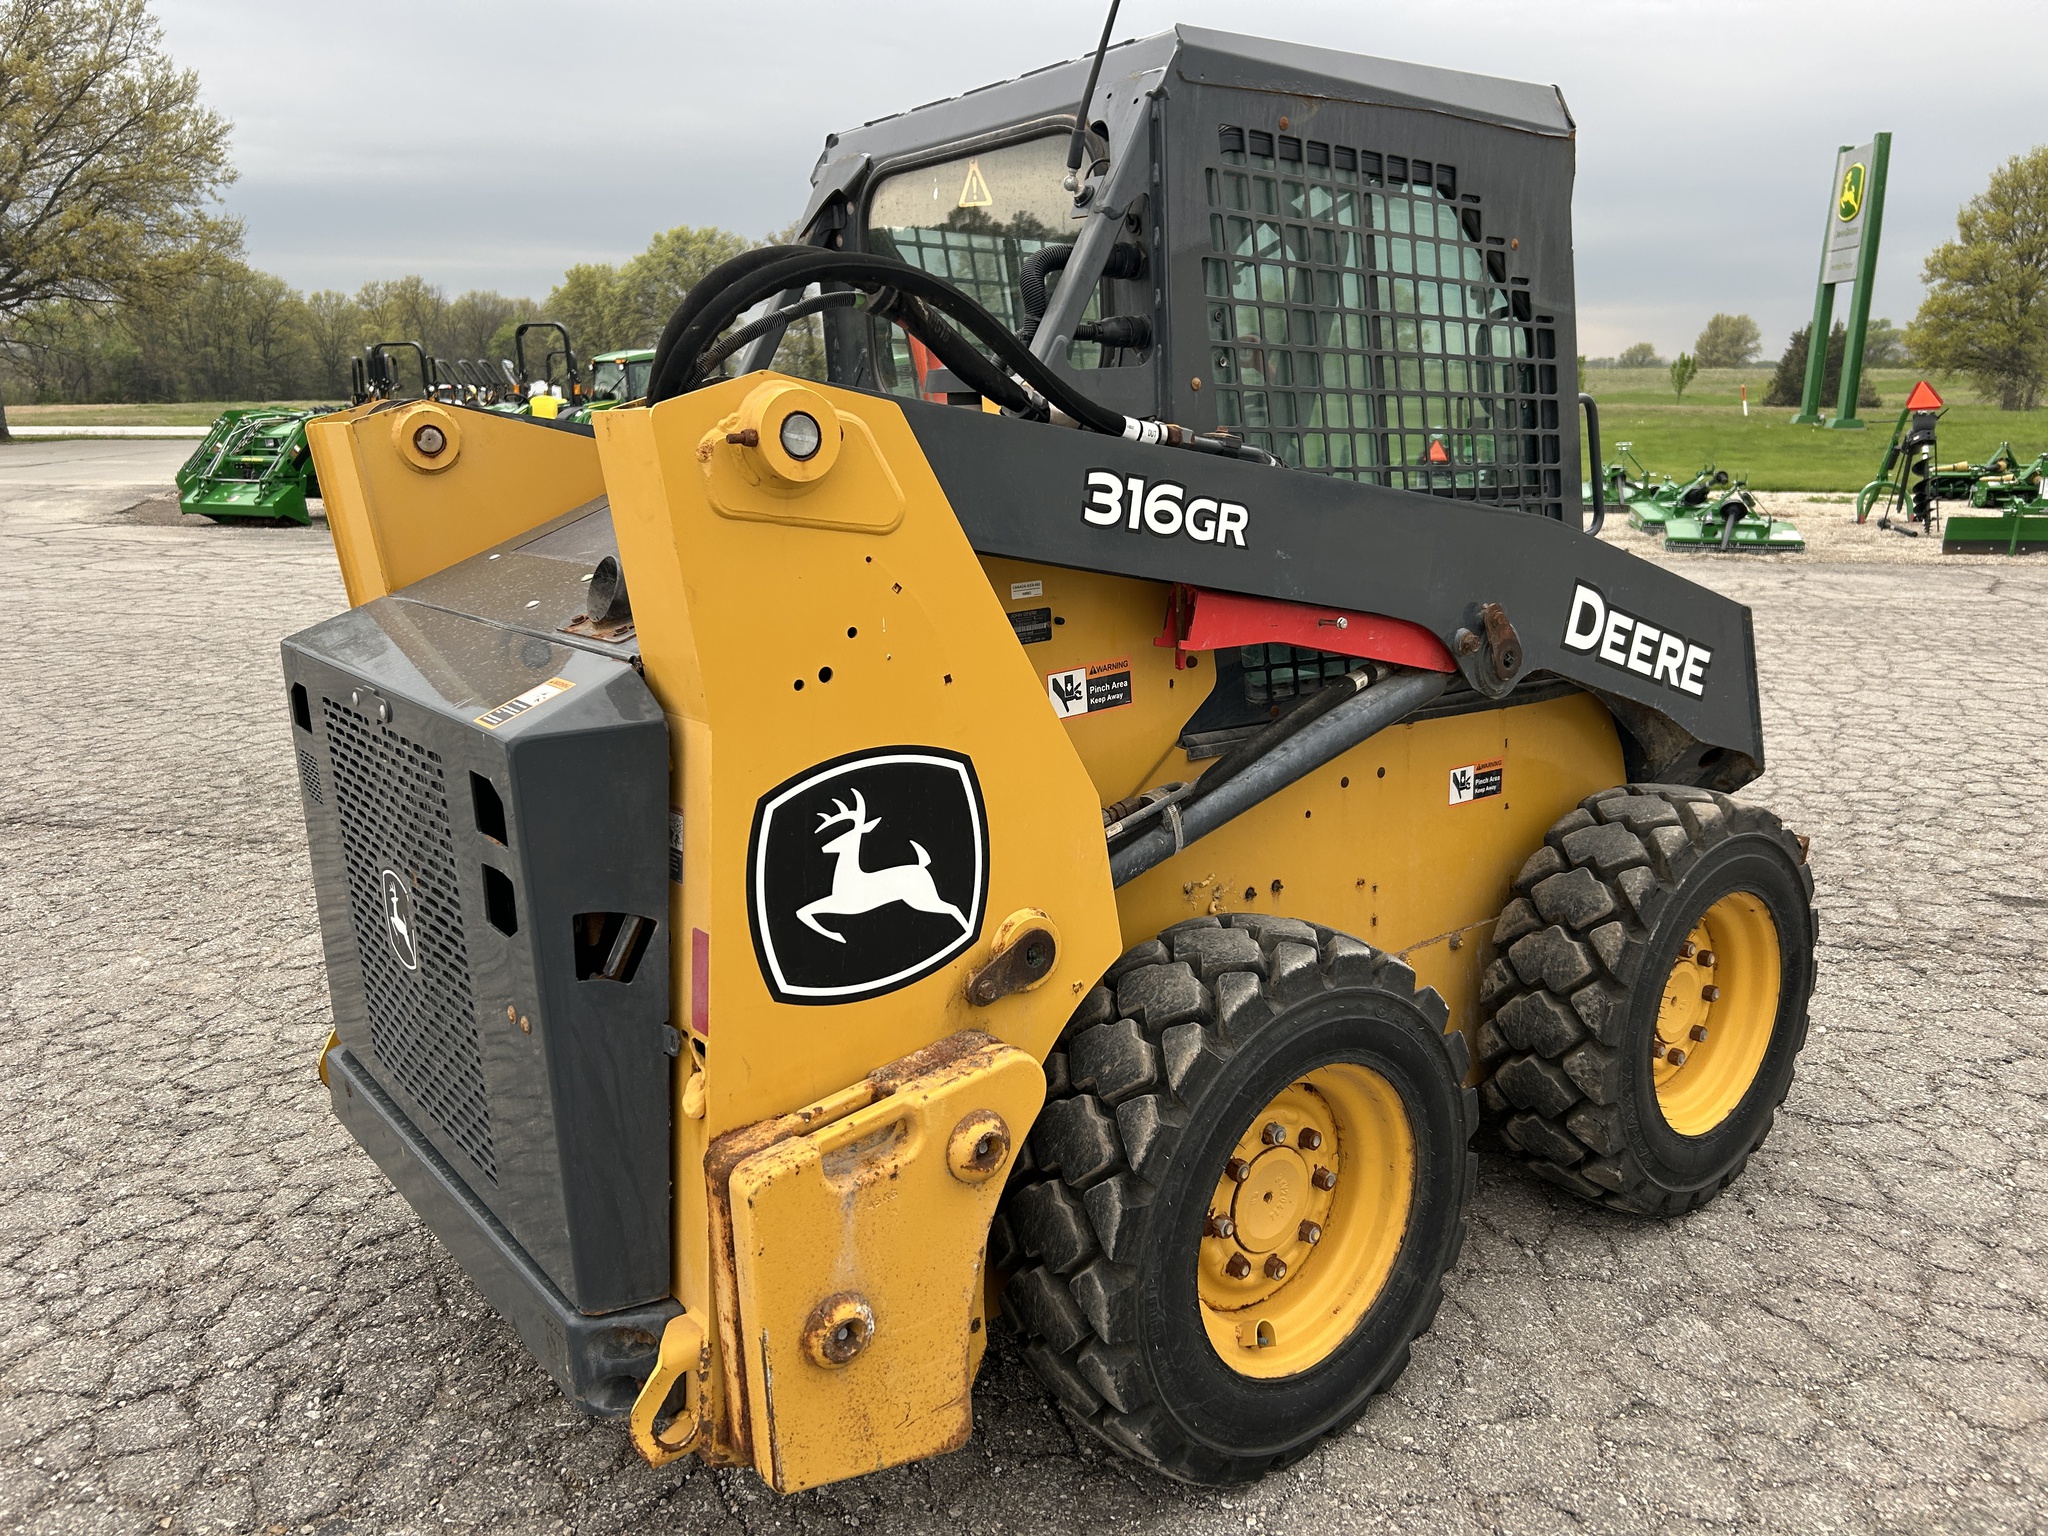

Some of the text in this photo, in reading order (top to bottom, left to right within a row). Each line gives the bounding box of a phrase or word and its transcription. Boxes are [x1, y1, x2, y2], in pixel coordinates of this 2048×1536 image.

[1083, 472, 1249, 547] 316GR
[1564, 584, 1712, 696] DEERE
[1096, 660, 1129, 673] WARNING
[1089, 680, 1128, 695] Pinch Area
[1090, 692, 1123, 705] Keep Away
[1475, 777, 1489, 786] Pinch
